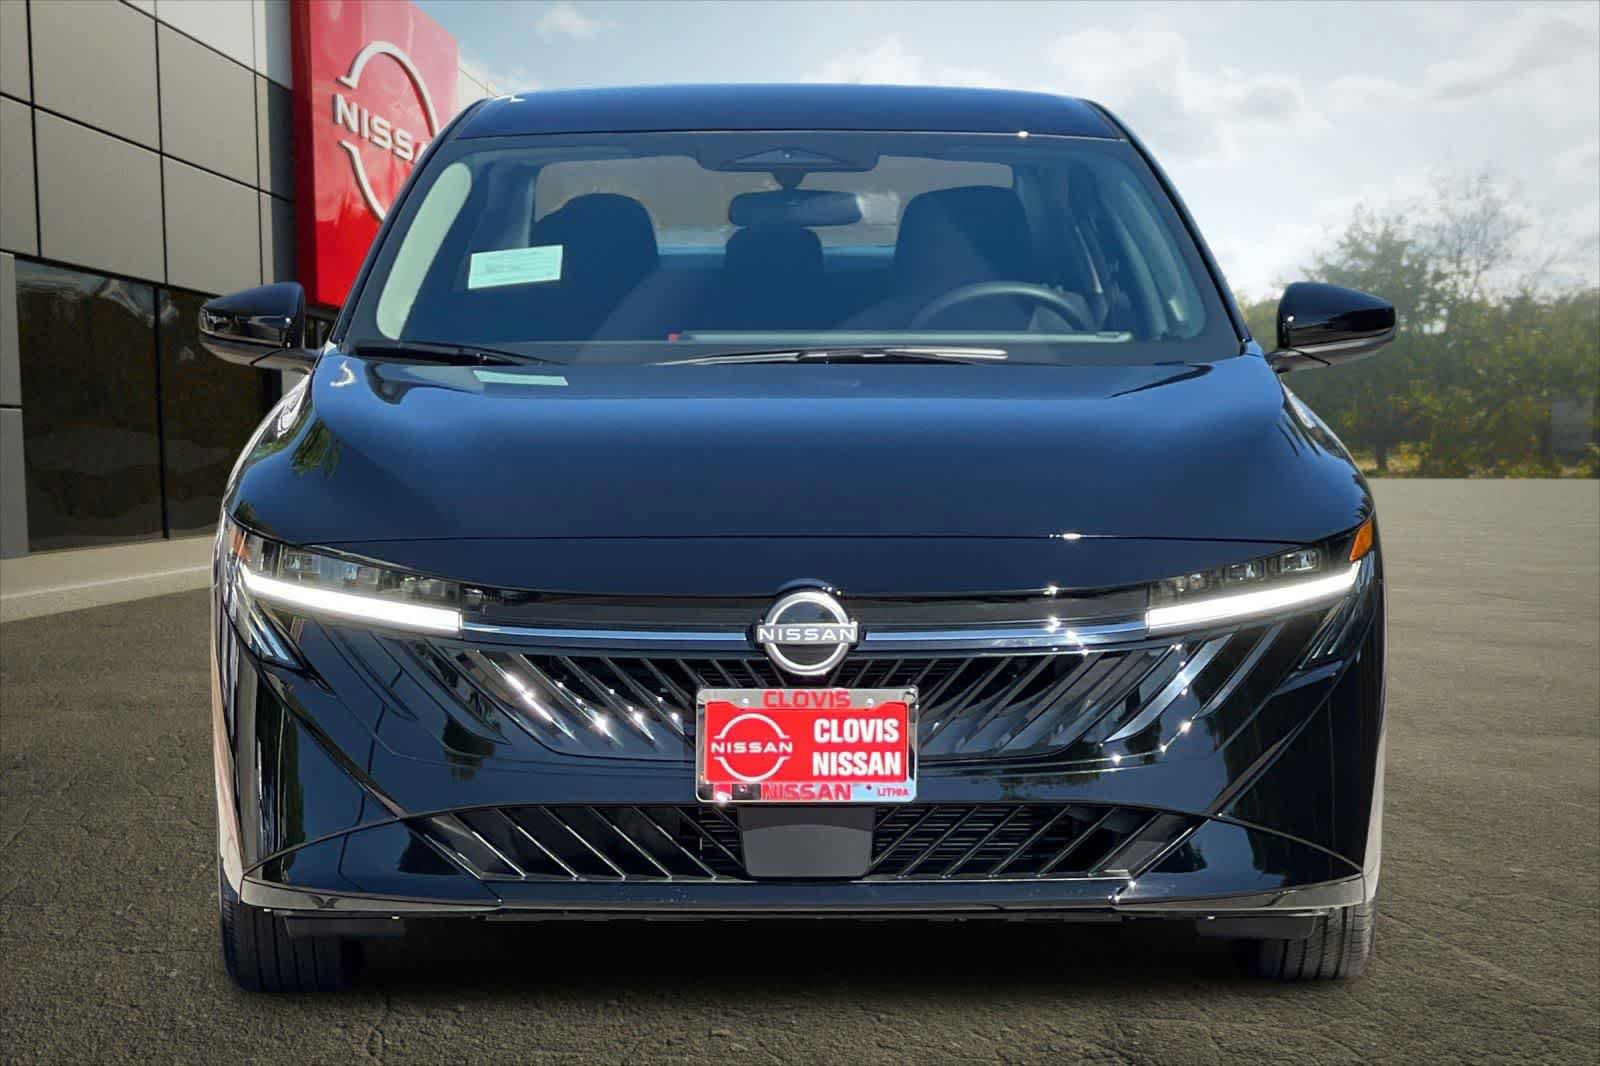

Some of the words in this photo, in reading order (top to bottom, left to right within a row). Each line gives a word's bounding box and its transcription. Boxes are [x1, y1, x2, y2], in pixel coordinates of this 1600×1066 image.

[758, 628, 856, 641] NISSAN
[763, 691, 851, 708] CLOVIS
[813, 717, 899, 744] CLOVIS
[711, 741, 793, 754] NISSAN
[812, 751, 901, 777] NISSAN
[761, 784, 850, 800] NISSAN
[877, 787, 909, 797] LITHIA
